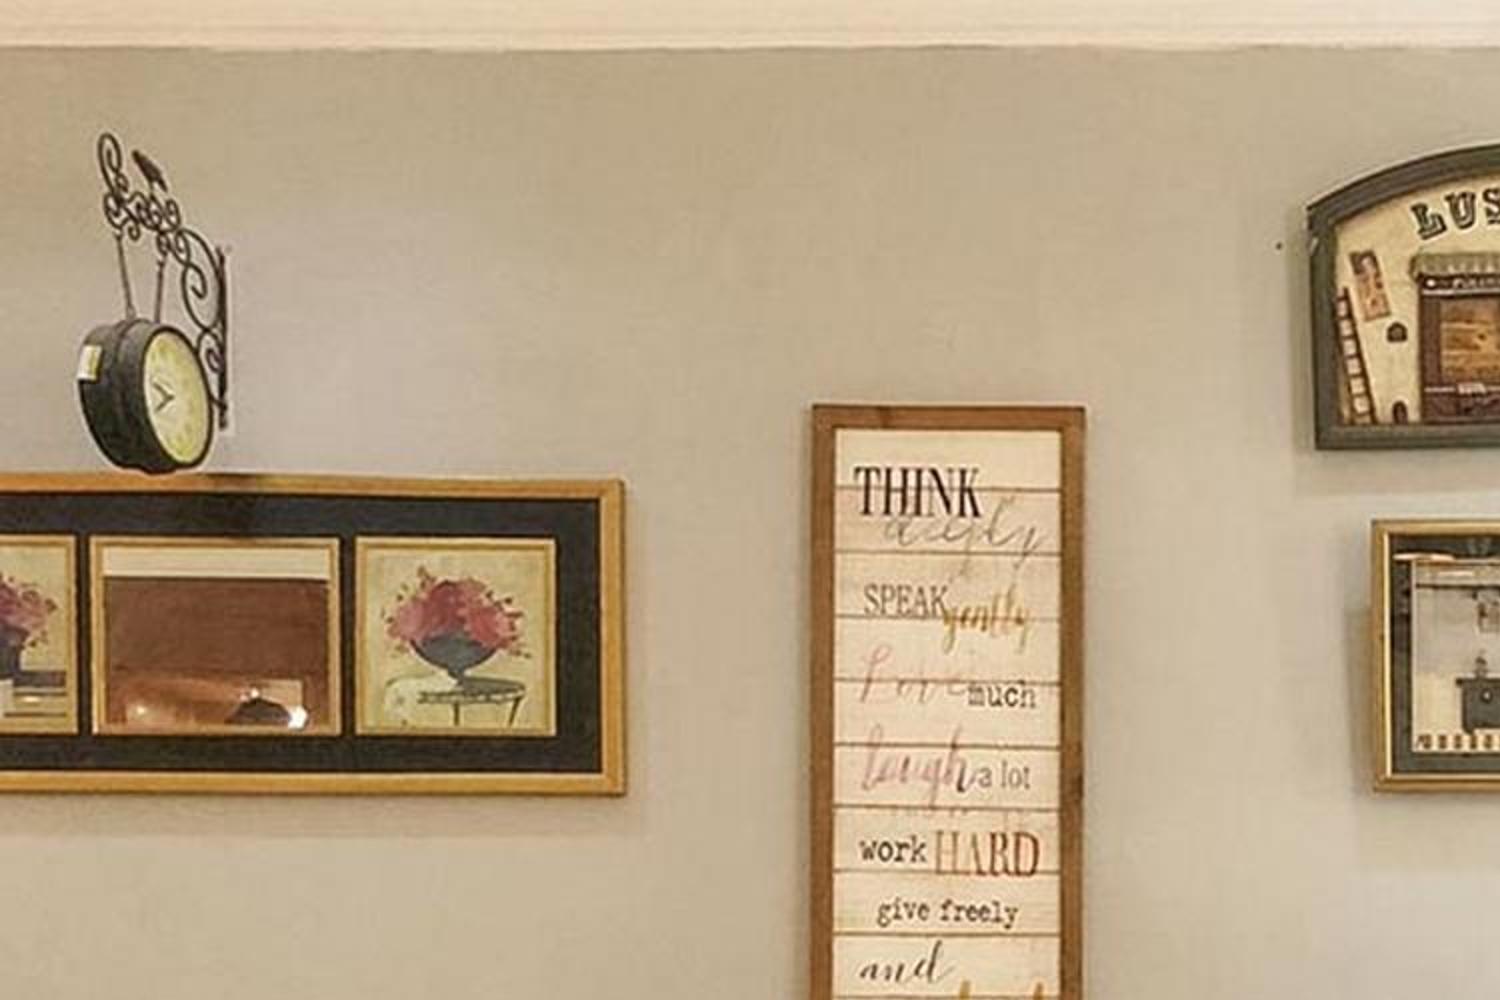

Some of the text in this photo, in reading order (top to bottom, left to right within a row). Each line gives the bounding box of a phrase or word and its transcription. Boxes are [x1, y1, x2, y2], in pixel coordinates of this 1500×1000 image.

[853, 466, 982, 518] THINK
[863, 583, 948, 617] SPEAK
[966, 677, 1036, 708] much
[861, 723, 1031, 806] laugh a lot
[859, 830, 1041, 877] work HARD
[876, 897, 1019, 930] give freely
[858, 940, 952, 984] and
